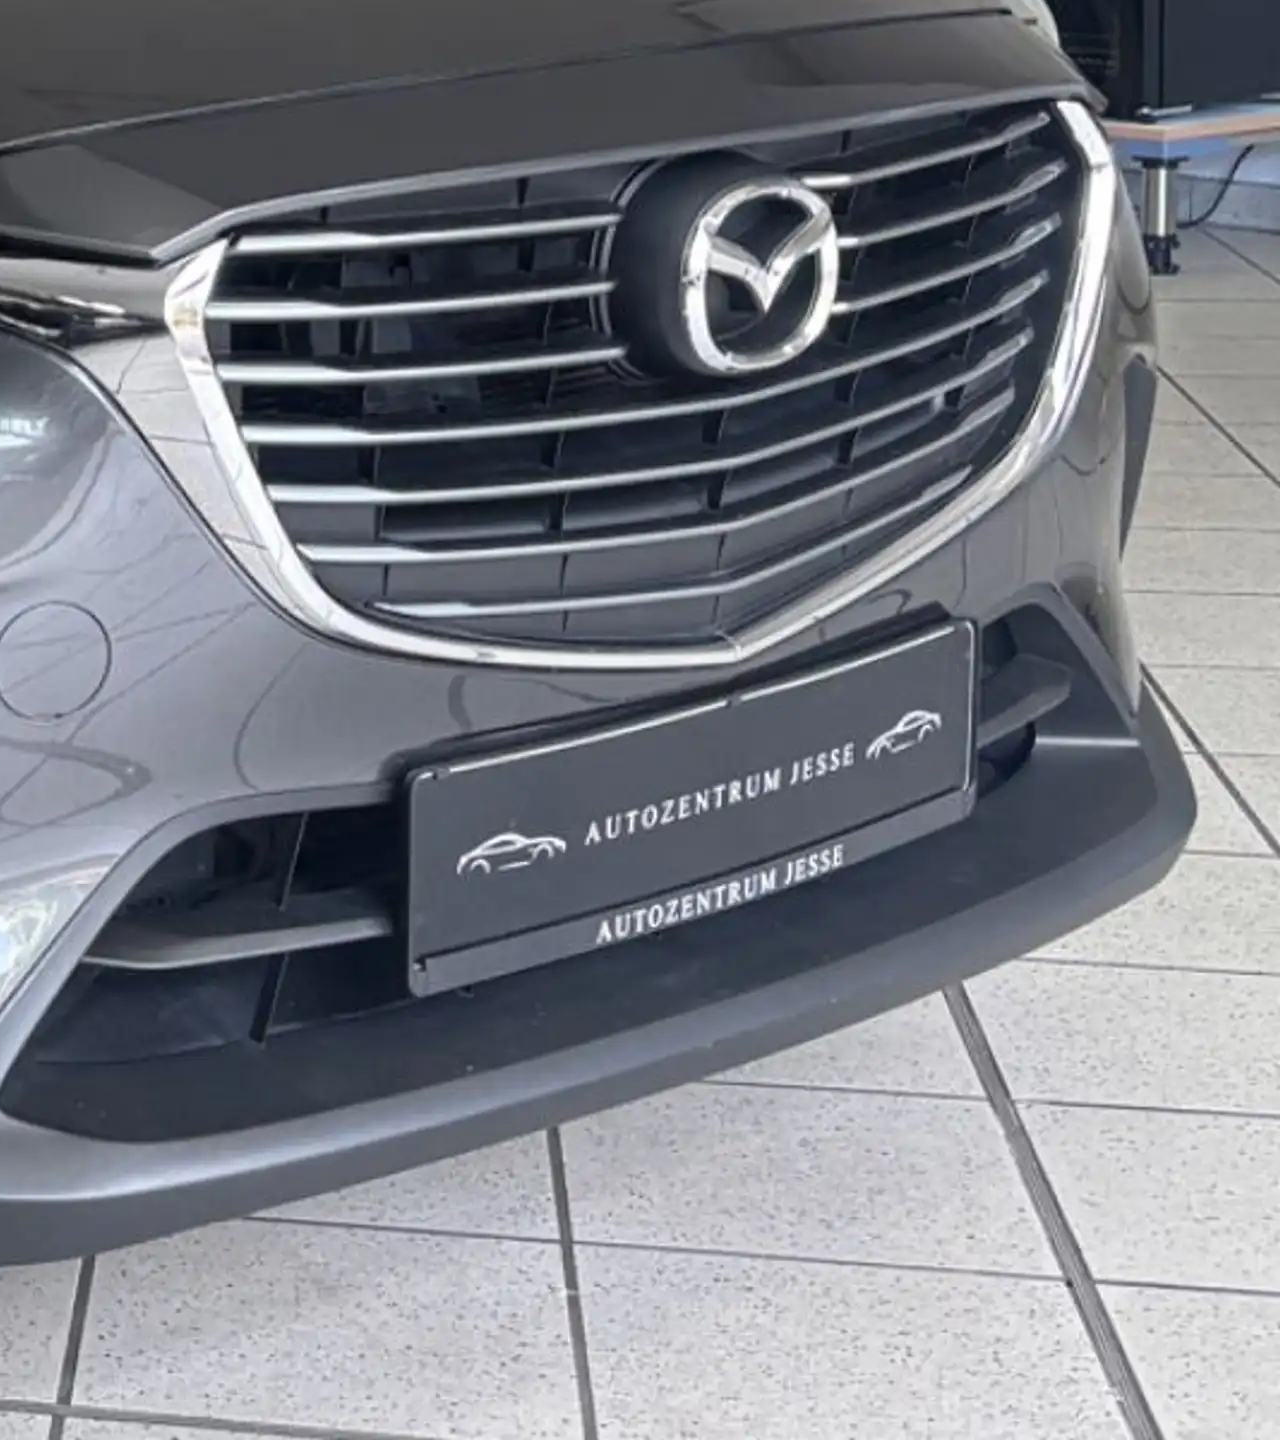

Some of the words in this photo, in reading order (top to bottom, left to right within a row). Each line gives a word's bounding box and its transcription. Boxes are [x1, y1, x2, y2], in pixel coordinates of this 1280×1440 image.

[584, 767, 782, 846] AUTOZENTRUM
[789, 742, 855, 786] JESSE
[595, 868, 776, 945] AUTOZENTRUM
[784, 844, 844, 886] JESSE
